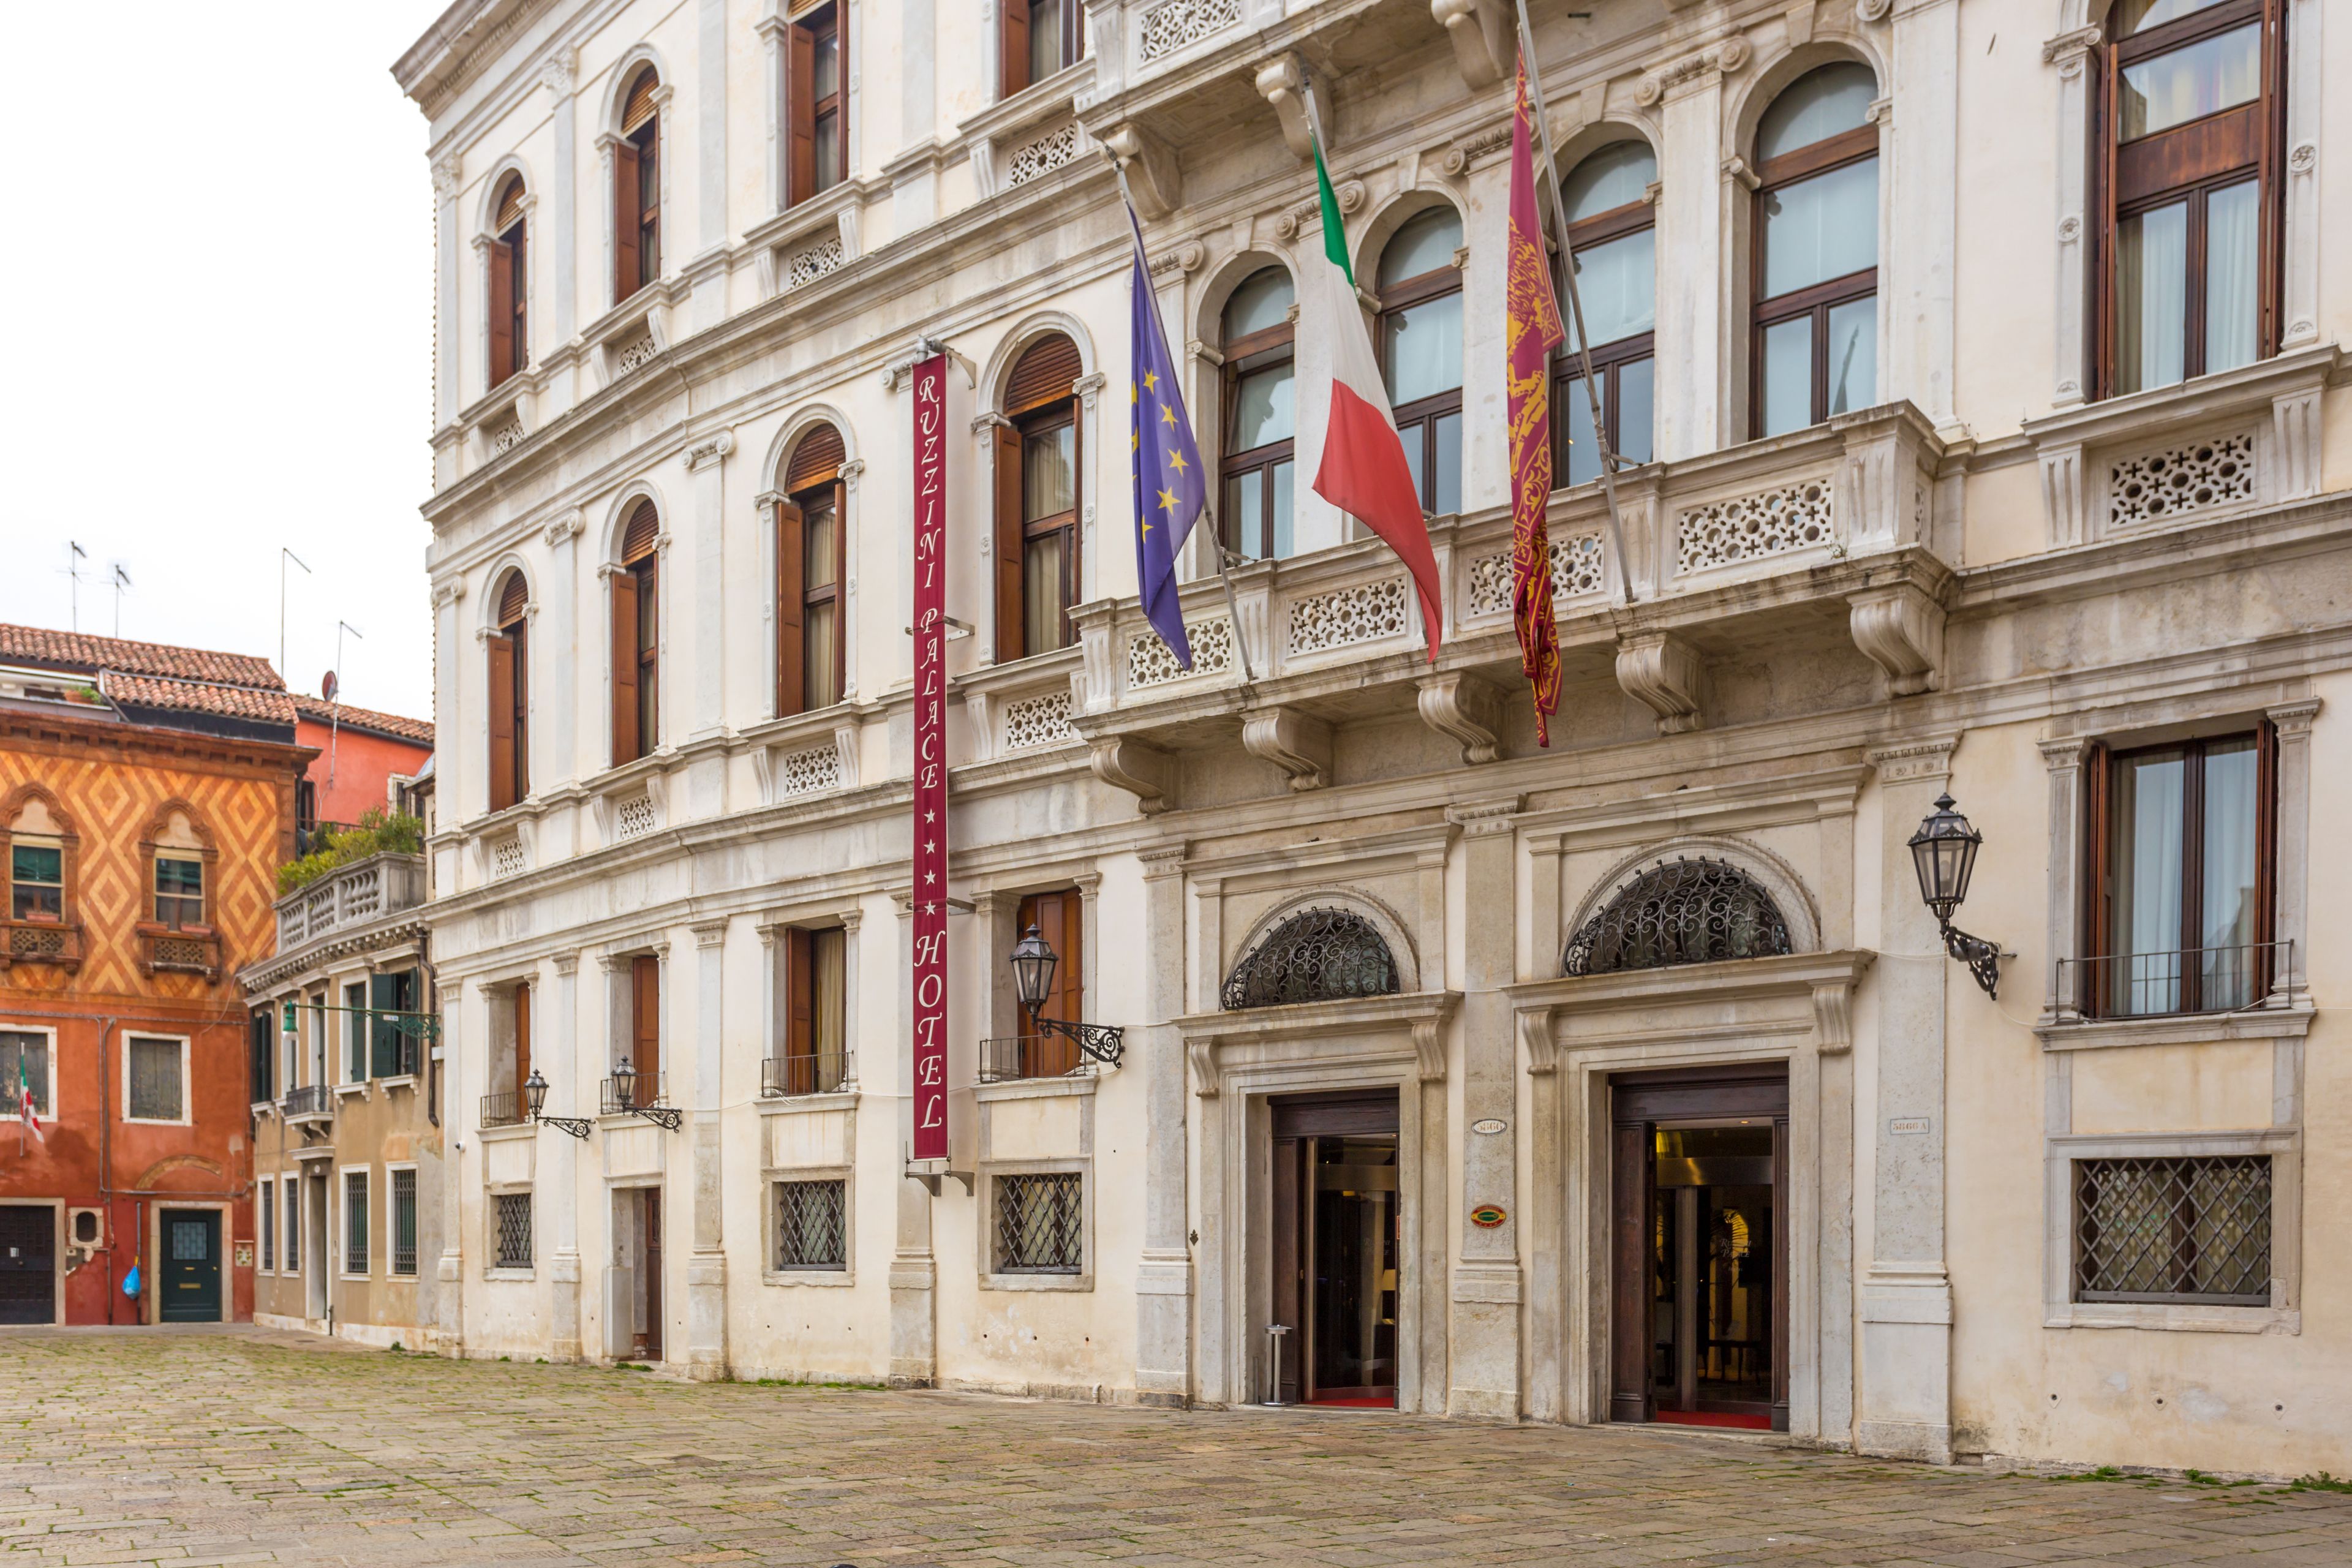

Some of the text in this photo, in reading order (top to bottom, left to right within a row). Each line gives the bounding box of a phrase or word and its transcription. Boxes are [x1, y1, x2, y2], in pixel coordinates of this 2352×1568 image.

[914, 375, 946, 1128] RUZZINI PALACE HOTEL
